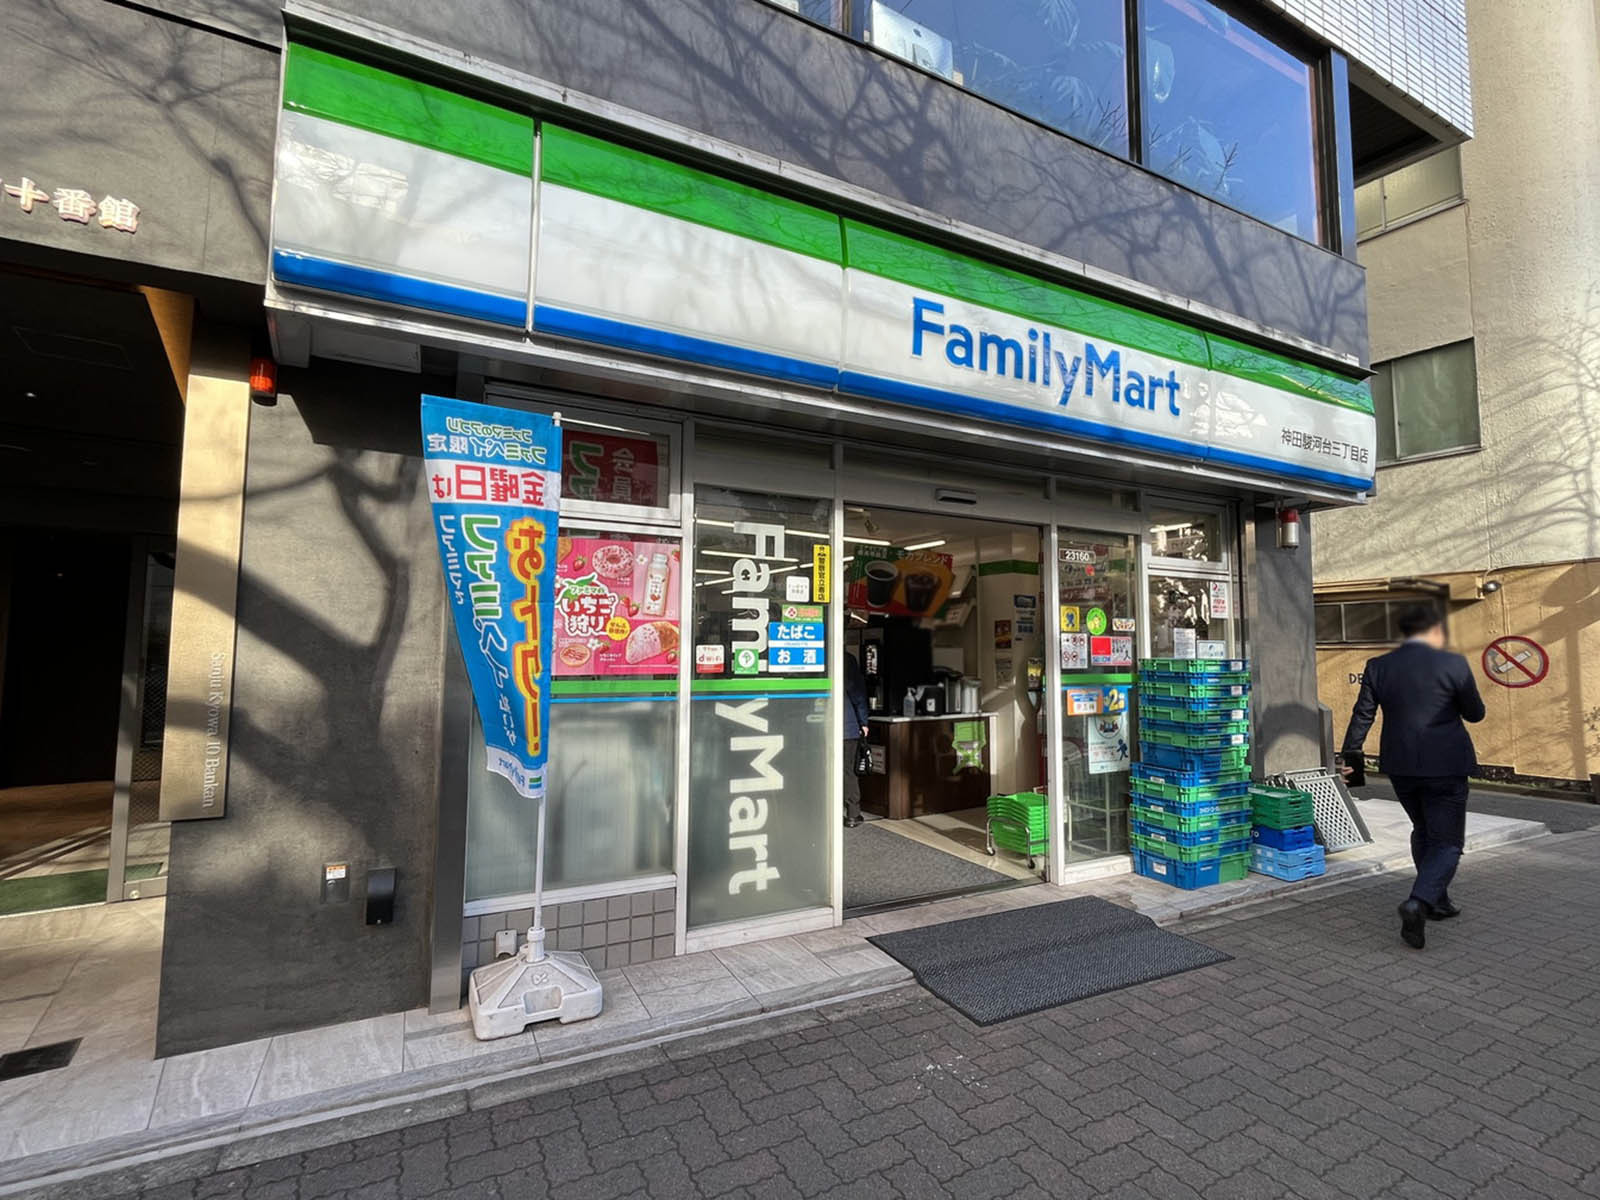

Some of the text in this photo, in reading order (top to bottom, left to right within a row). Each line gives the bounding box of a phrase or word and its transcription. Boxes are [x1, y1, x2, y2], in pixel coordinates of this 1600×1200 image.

[4, 176, 141, 233] 十番館
[911, 296, 1181, 417] FamilyMart
[1281, 427, 1369, 464] 神田駿河台三丁目店
[561, 596, 616, 615] いちご
[569, 614, 605, 634] 狩り
[777, 624, 816, 640] たばこ
[777, 648, 817, 664] お酒
[206, 690, 224, 737] Kyowa
[202, 757, 220, 808] Bankan
